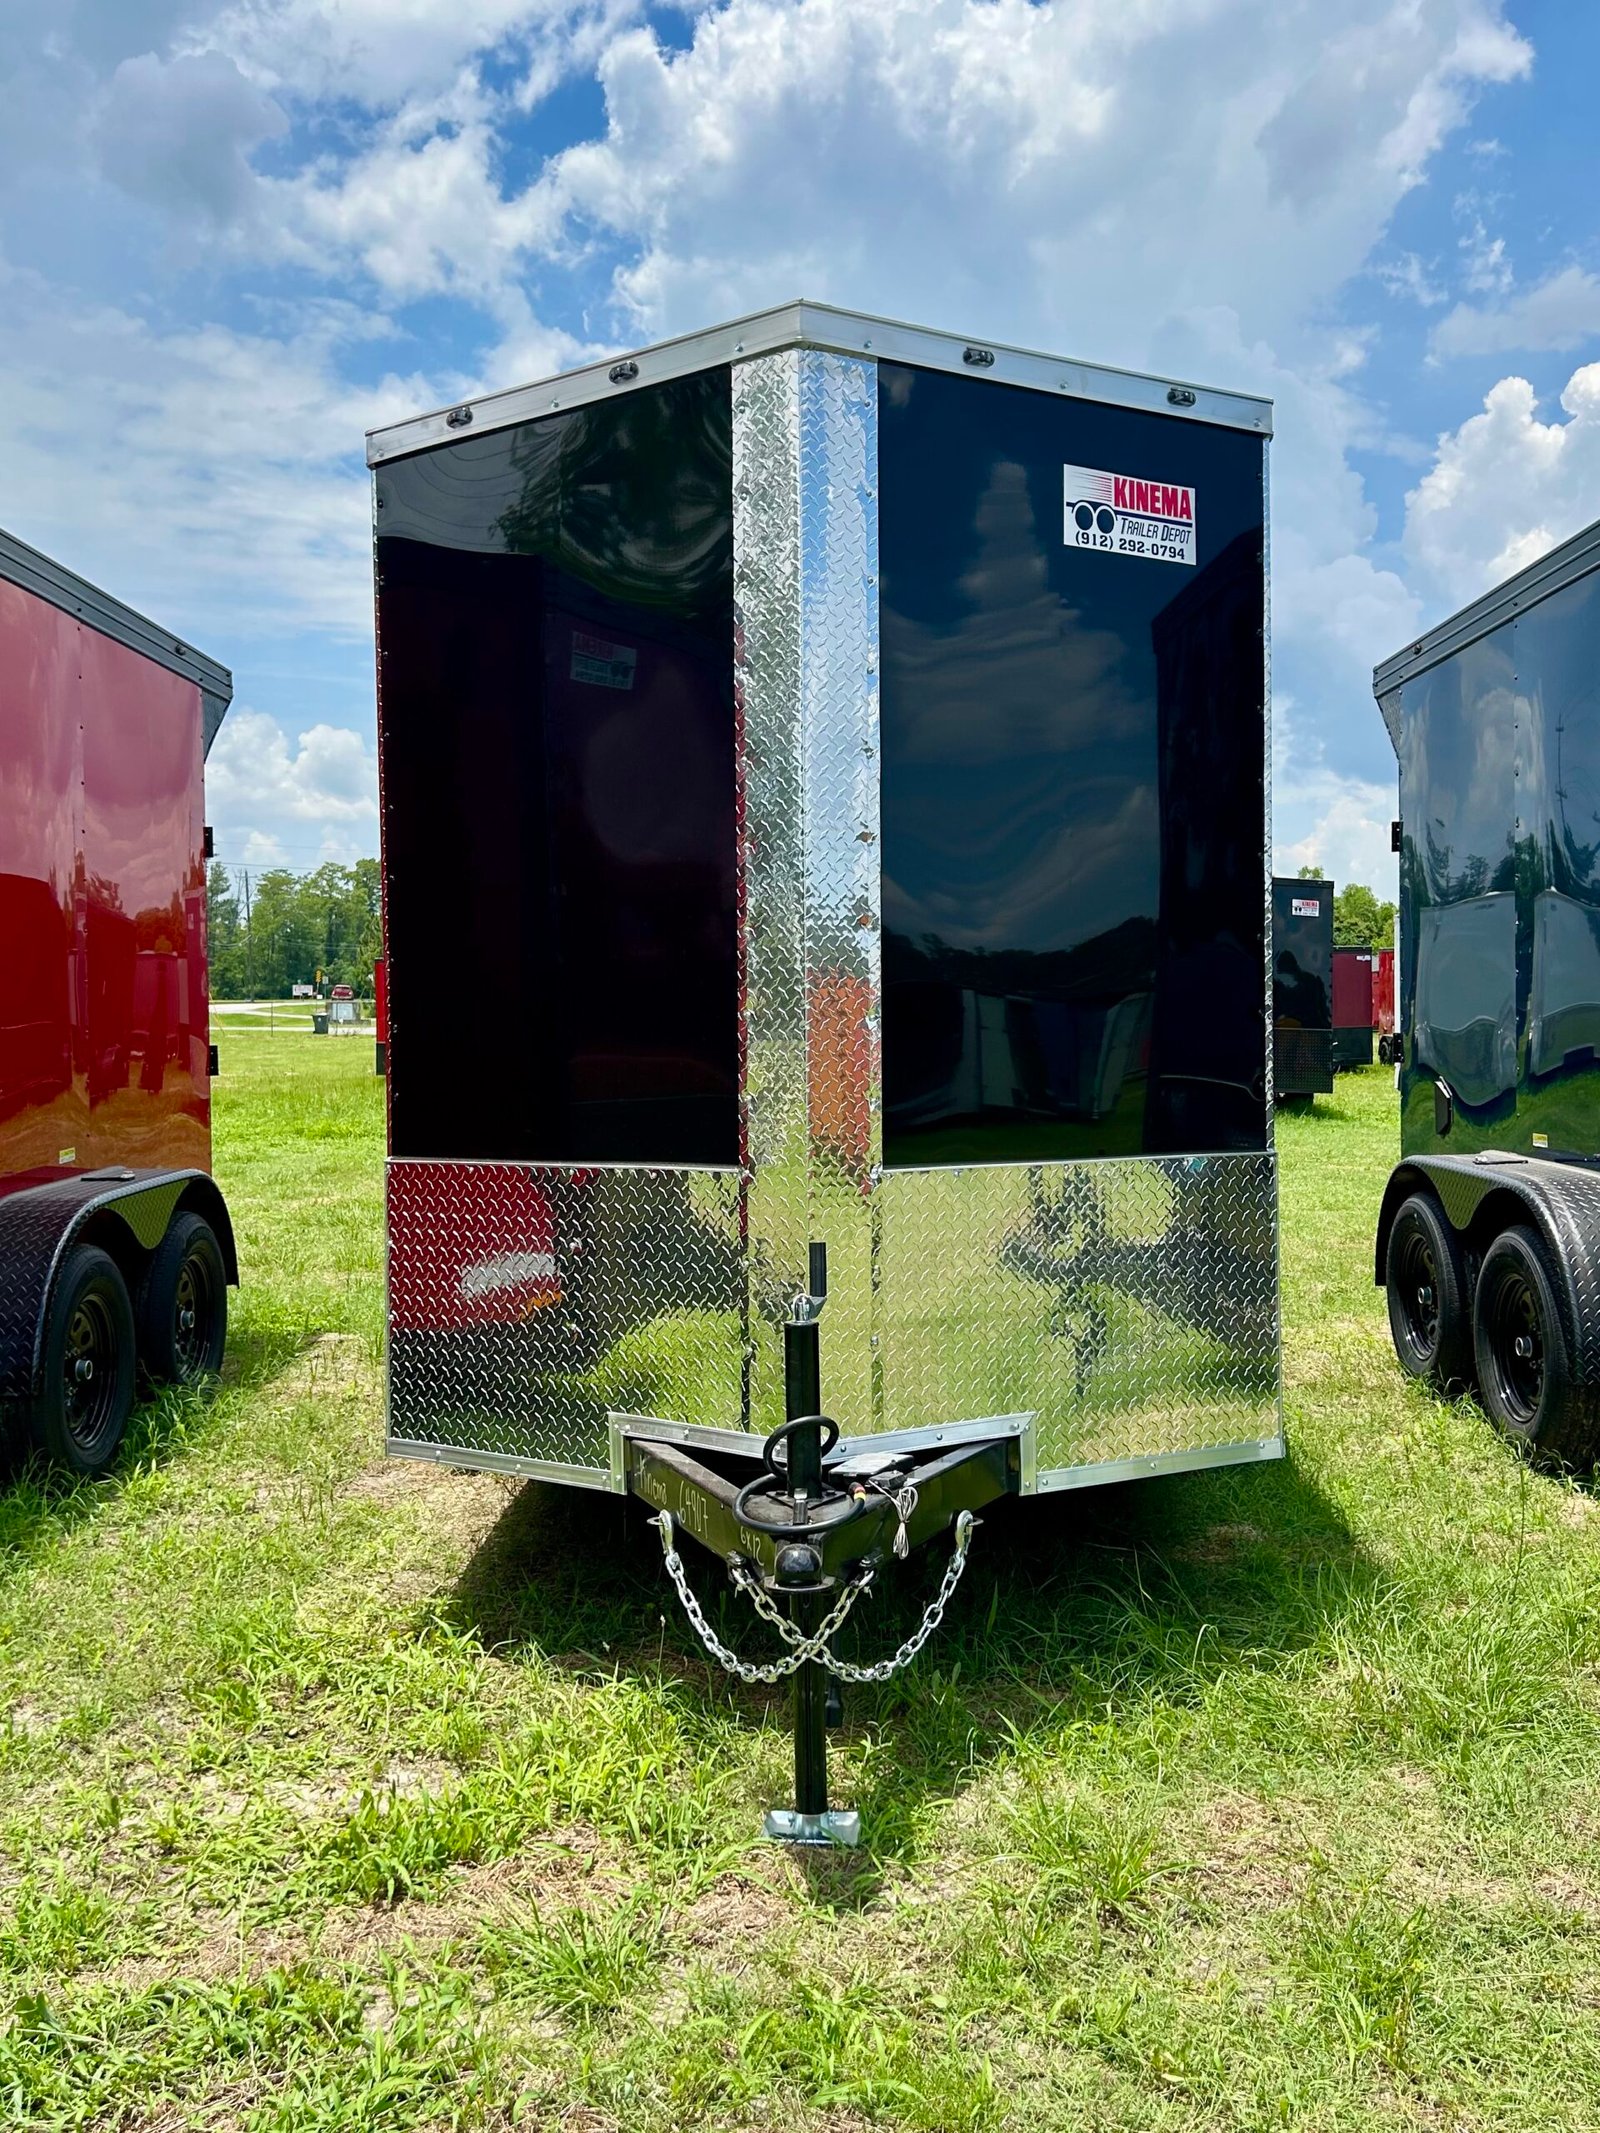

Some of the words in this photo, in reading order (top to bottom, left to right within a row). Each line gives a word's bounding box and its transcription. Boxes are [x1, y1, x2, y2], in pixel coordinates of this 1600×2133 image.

[1113, 476, 1193, 521] KINEMA
[1075, 530, 1114, 550] (912)
[1119, 538, 1186, 560] 292-0794
[1120, 517, 1159, 539] TRAILER
[1160, 524, 1192, 545] DEPOT
